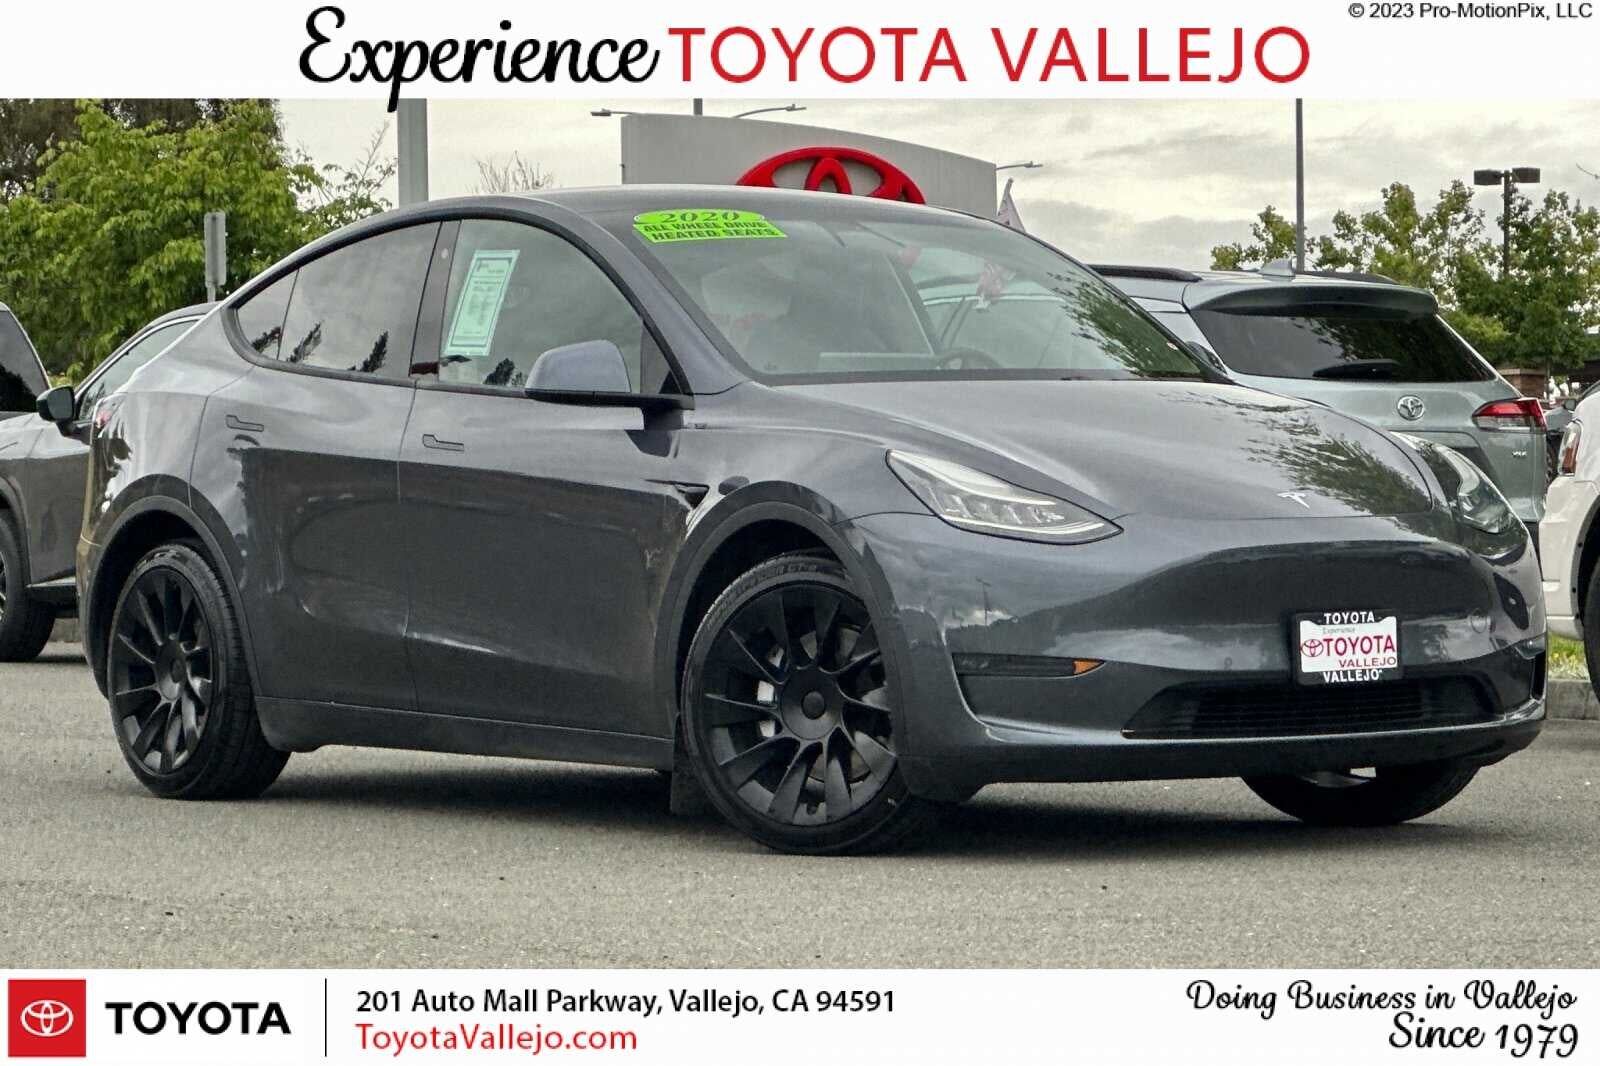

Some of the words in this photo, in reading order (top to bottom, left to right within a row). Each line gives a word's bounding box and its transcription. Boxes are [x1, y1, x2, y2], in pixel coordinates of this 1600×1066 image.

[660, 212, 740, 223] 2020
[643, 223, 674, 232] ALL
[672, 222, 722, 230] WHEEL
[652, 230, 720, 240] HEATED
[722, 228, 779, 237] SEATS
[1324, 611, 1375, 624] TOYOTA
[1322, 634, 1396, 656] TOYOTA
[1338, 656, 1397, 668] VALLEJO
[1323, 668, 1380, 683] VALLEJO
